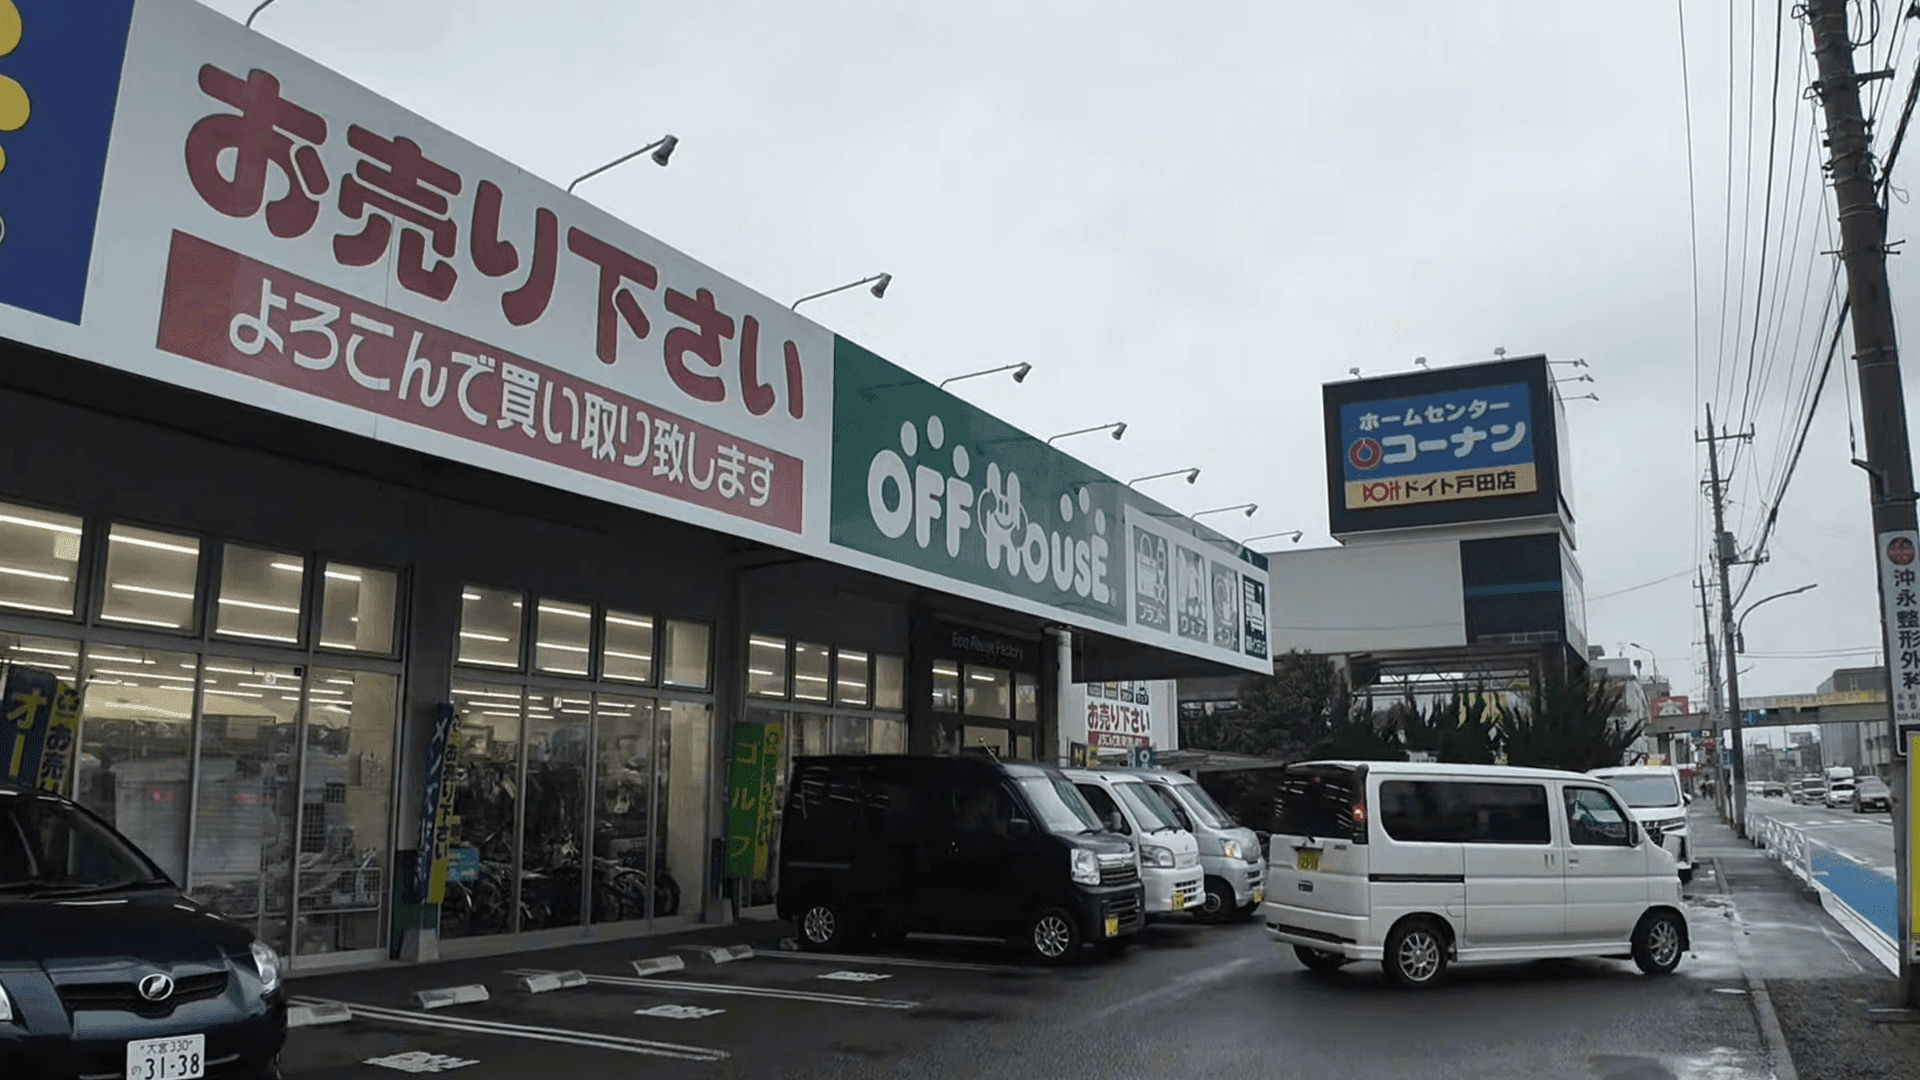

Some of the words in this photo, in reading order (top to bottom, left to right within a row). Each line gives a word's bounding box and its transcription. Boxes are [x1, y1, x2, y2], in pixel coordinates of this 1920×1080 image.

[185, 64, 804, 420] お売り下さい
[228, 279, 775, 507] よろこんで買い取り致します
[1358, 399, 1510, 431] ホームセンター
[1381, 421, 1526, 464] コーナン
[1404, 471, 1516, 499] ドイト戸田店
[868, 449, 974, 558] OFF
[985, 462, 1110, 604] HOUSE
[1894, 568, 1920, 690] 沖永整形外科
[1087, 701, 1151, 734] お売り下さい
[144, 1052, 200, 1080] 31-38
